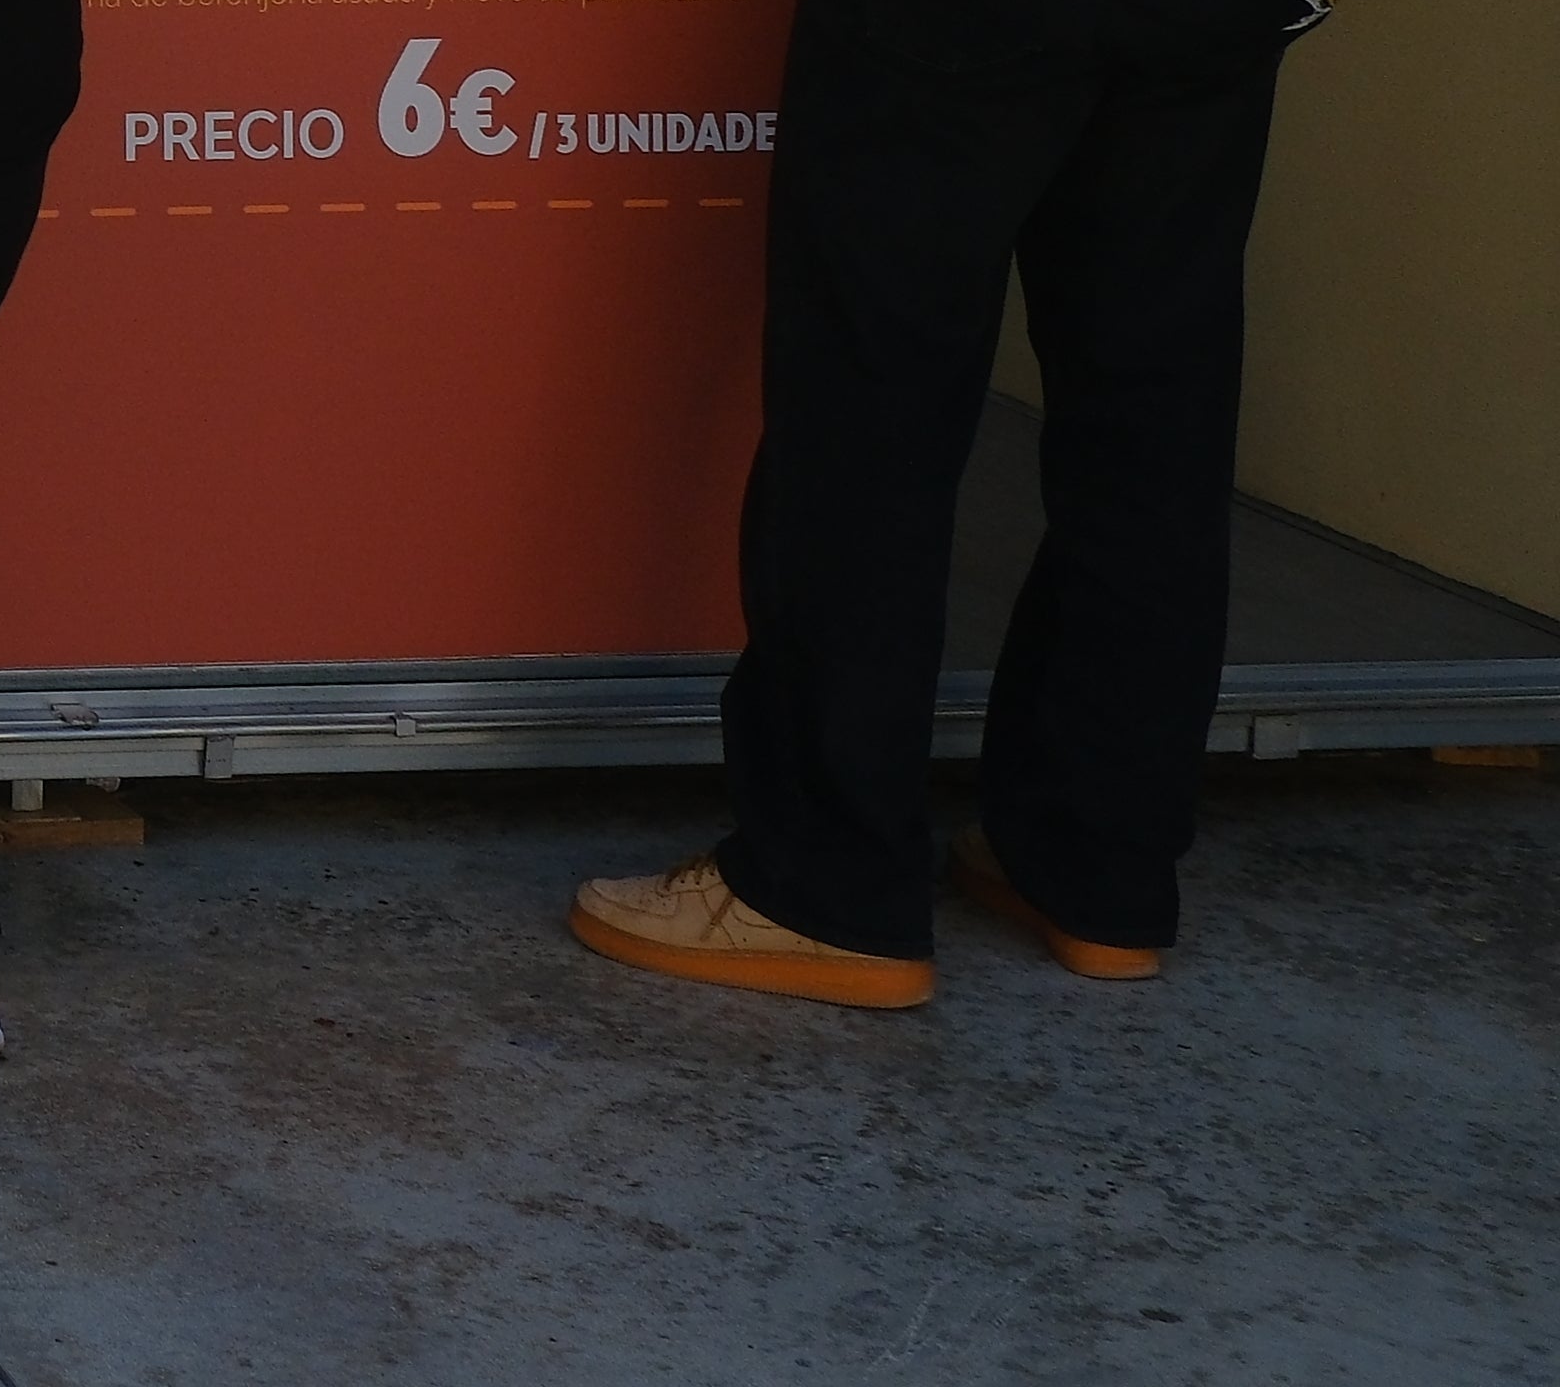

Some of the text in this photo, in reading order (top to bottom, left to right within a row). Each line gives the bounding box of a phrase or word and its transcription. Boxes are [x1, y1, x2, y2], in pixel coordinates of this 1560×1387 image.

[124, 107, 345, 163] PRECIO
[377, 37, 519, 159] 6€
[587, 111, 777, 154] UNIDADE
